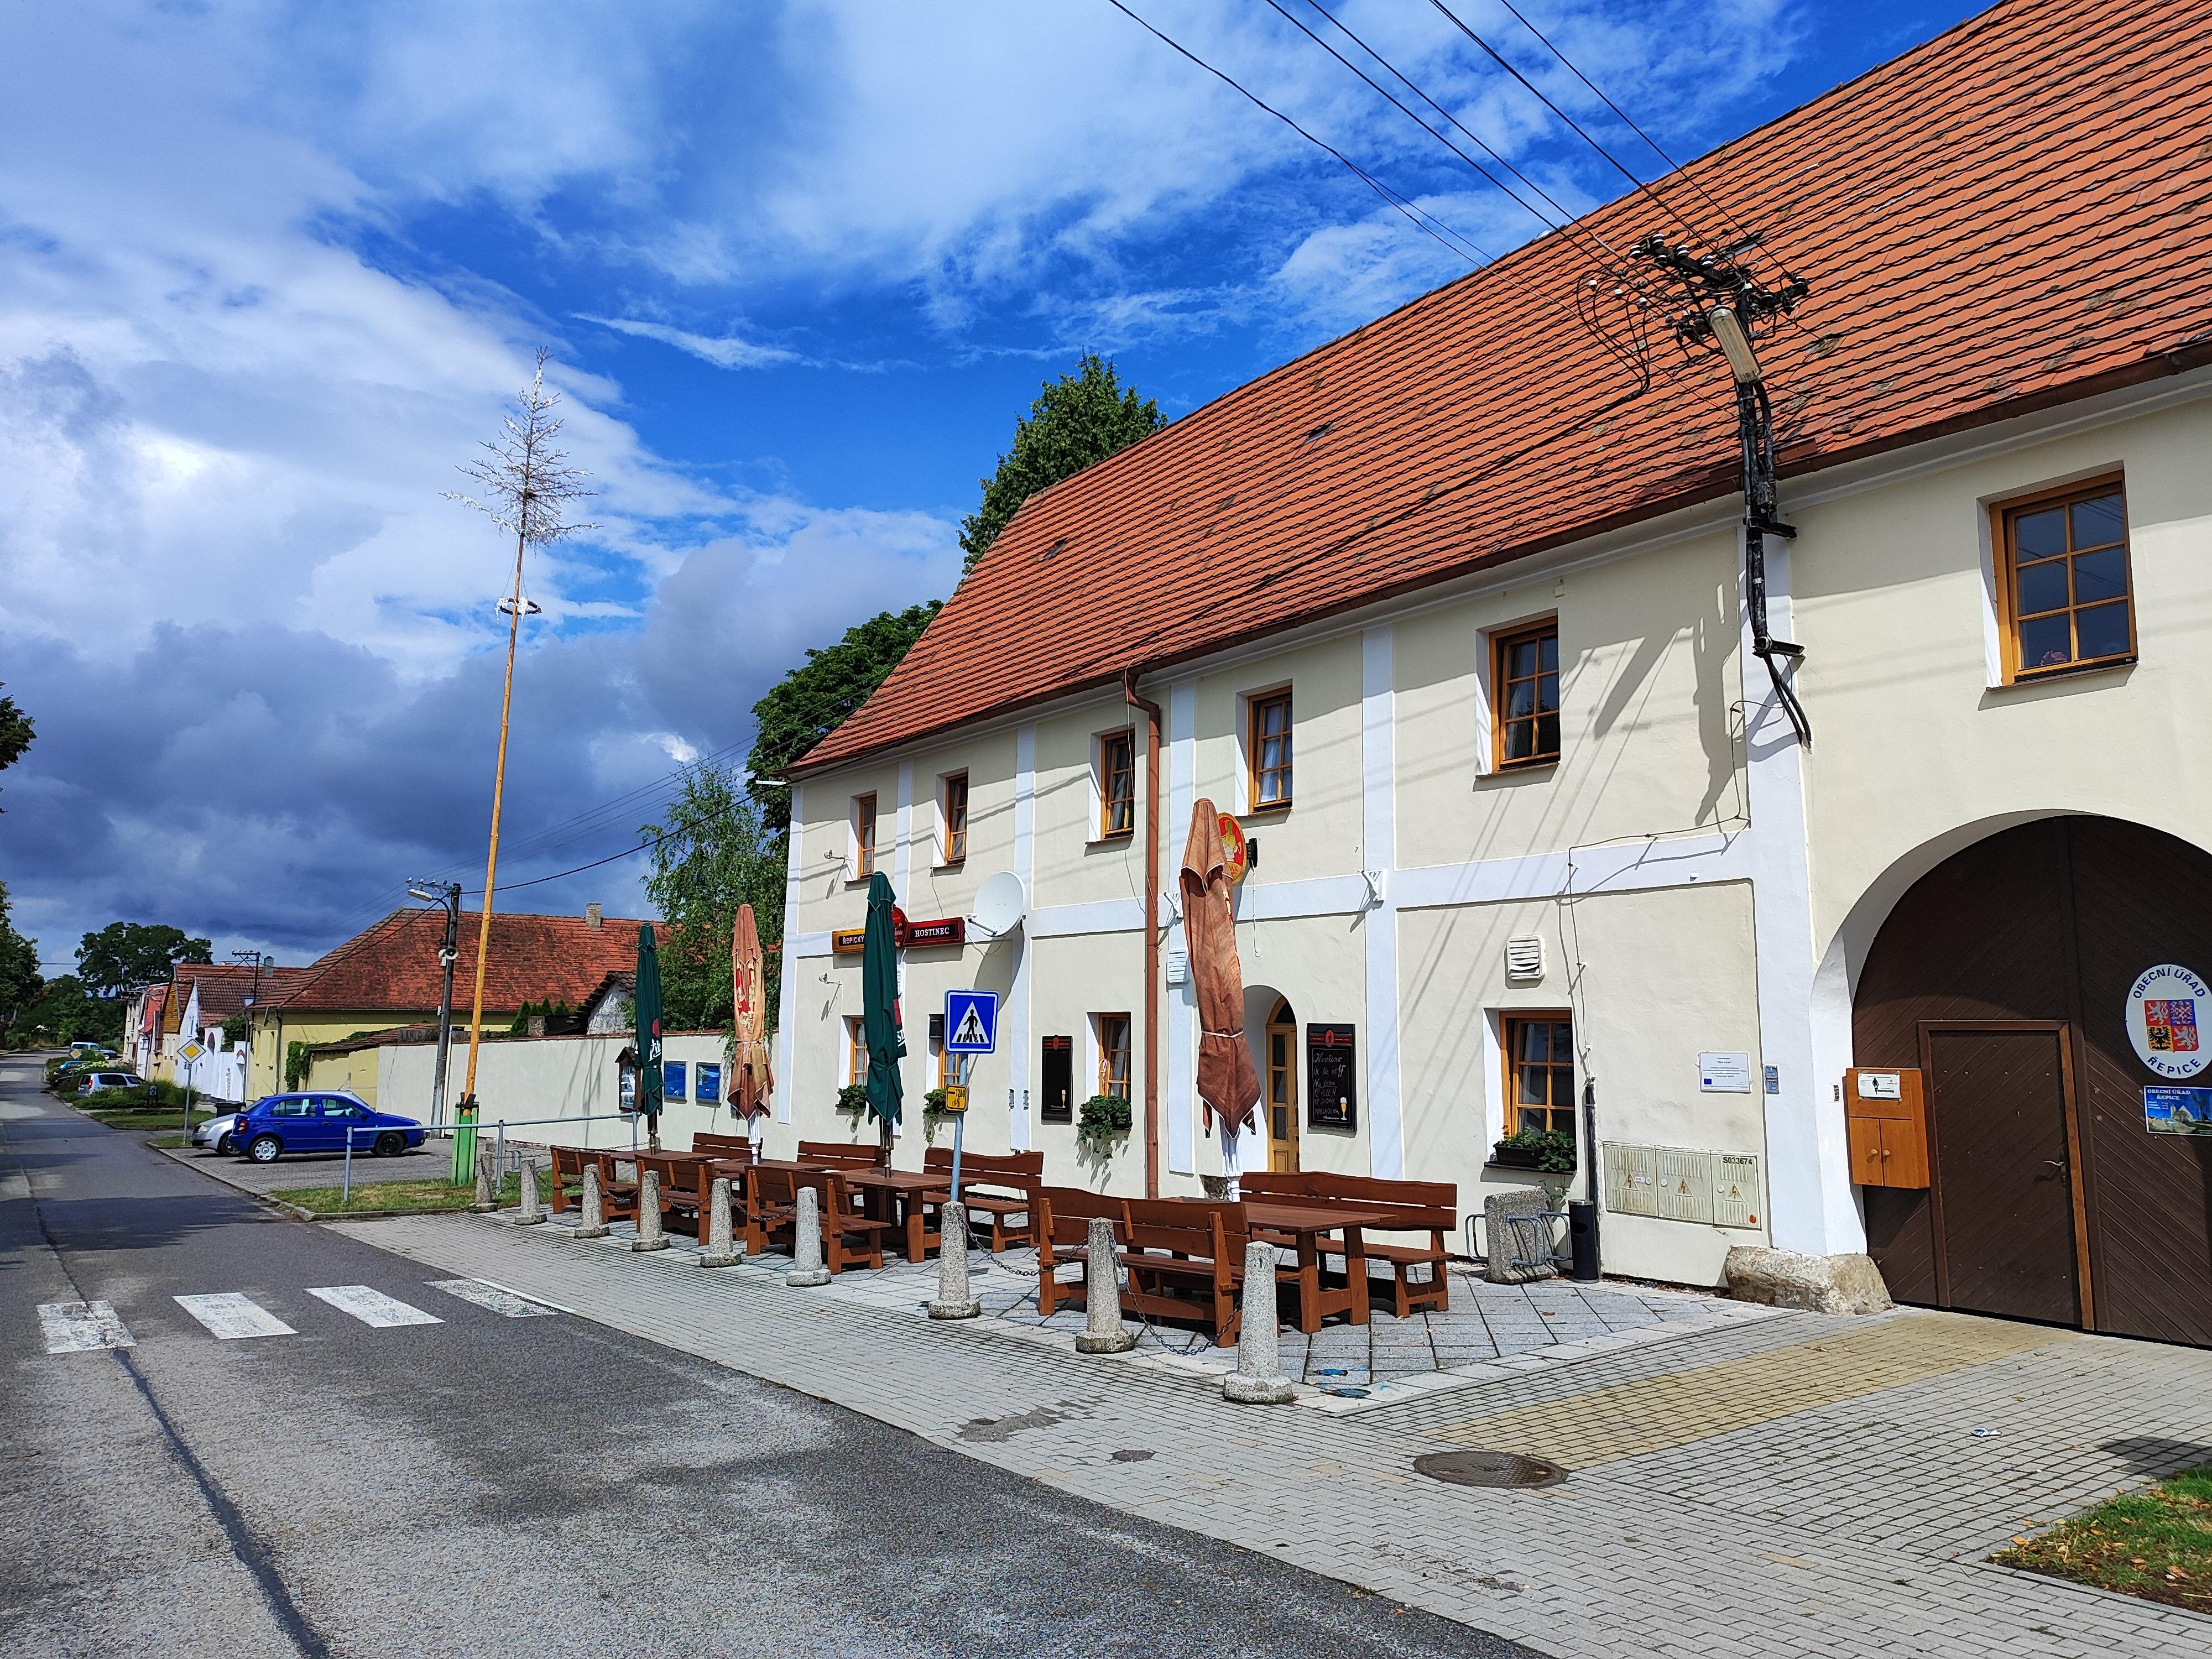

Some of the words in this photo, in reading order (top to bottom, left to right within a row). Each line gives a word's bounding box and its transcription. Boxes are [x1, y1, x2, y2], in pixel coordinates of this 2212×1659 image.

[915, 927, 950, 937] HOSTINEC
[843, 935, 864, 945] ŘEPICKÝ
[2133, 966, 2171, 999] OBECNÍ
[2174, 969, 2205, 997] ÚŘAD
[2147, 1056, 2201, 1075] ŘEPICE
[1723, 1156, 1752, 1165] S033674
